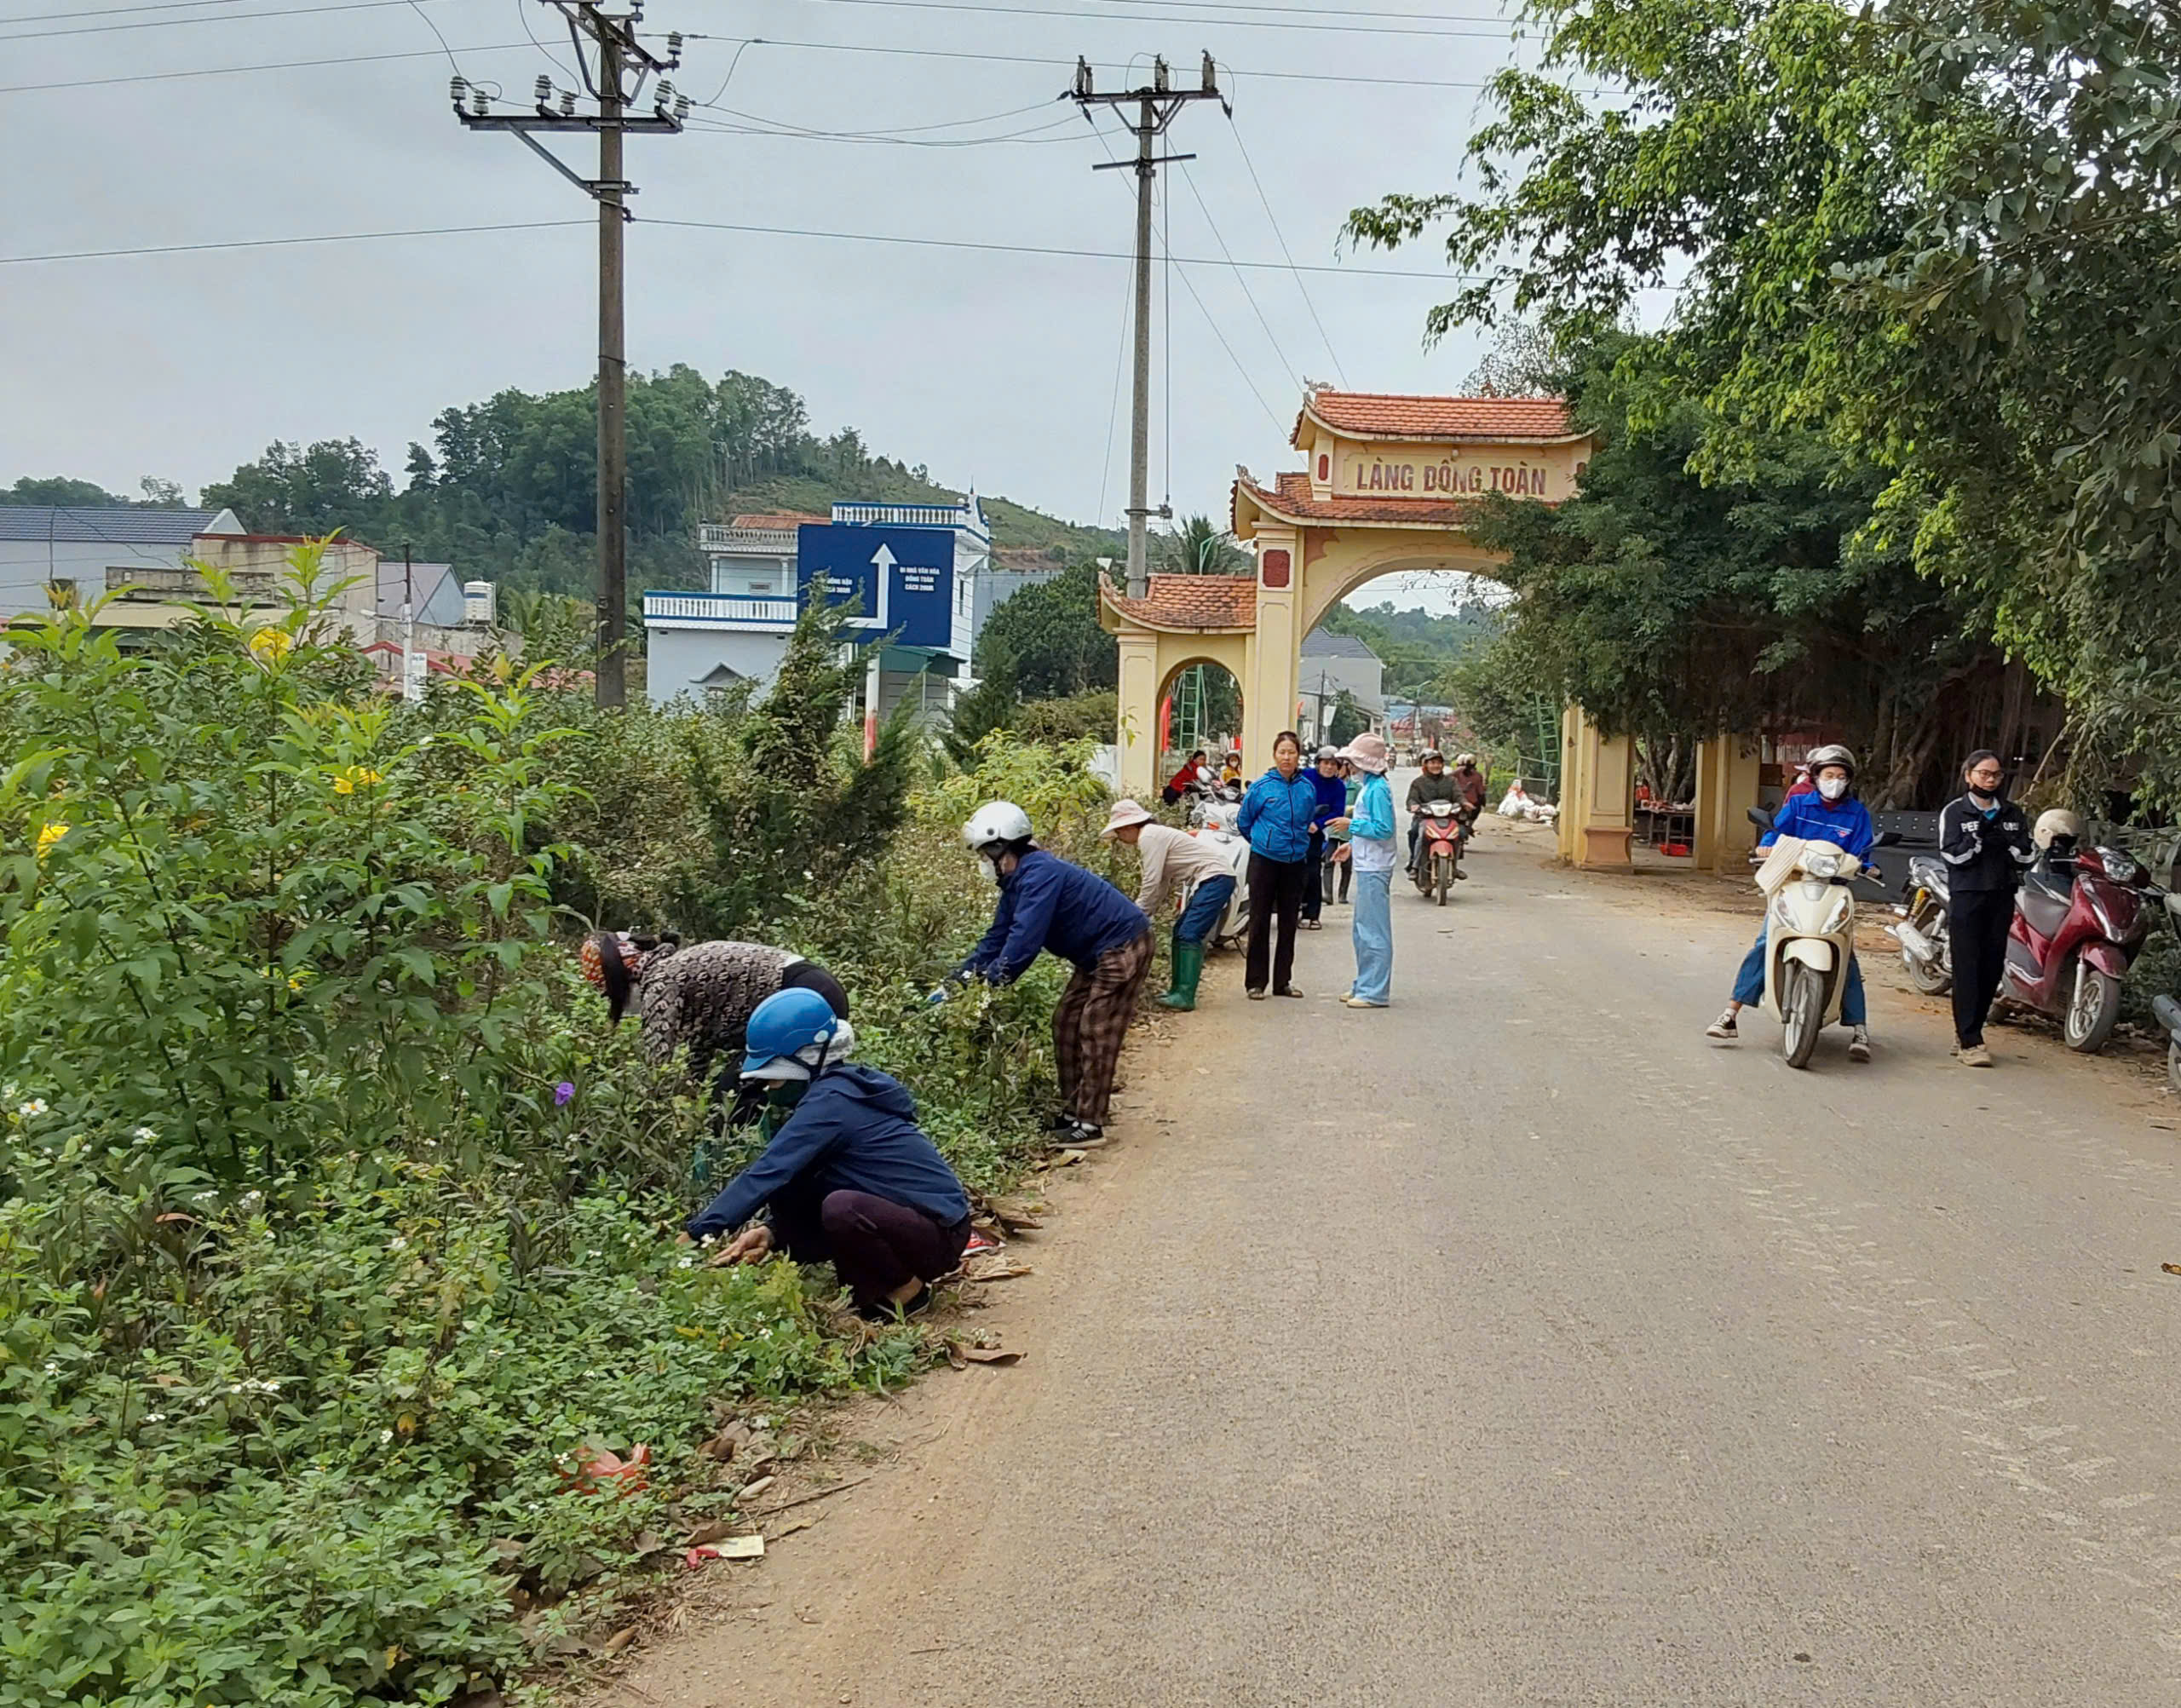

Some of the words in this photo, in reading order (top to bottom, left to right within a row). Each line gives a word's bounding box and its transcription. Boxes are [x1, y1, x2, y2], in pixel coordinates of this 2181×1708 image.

[1356, 457, 1414, 492] LÀNG
[1423, 457, 1482, 493] ĐỒNG
[1490, 460, 1546, 495] TOÀN
